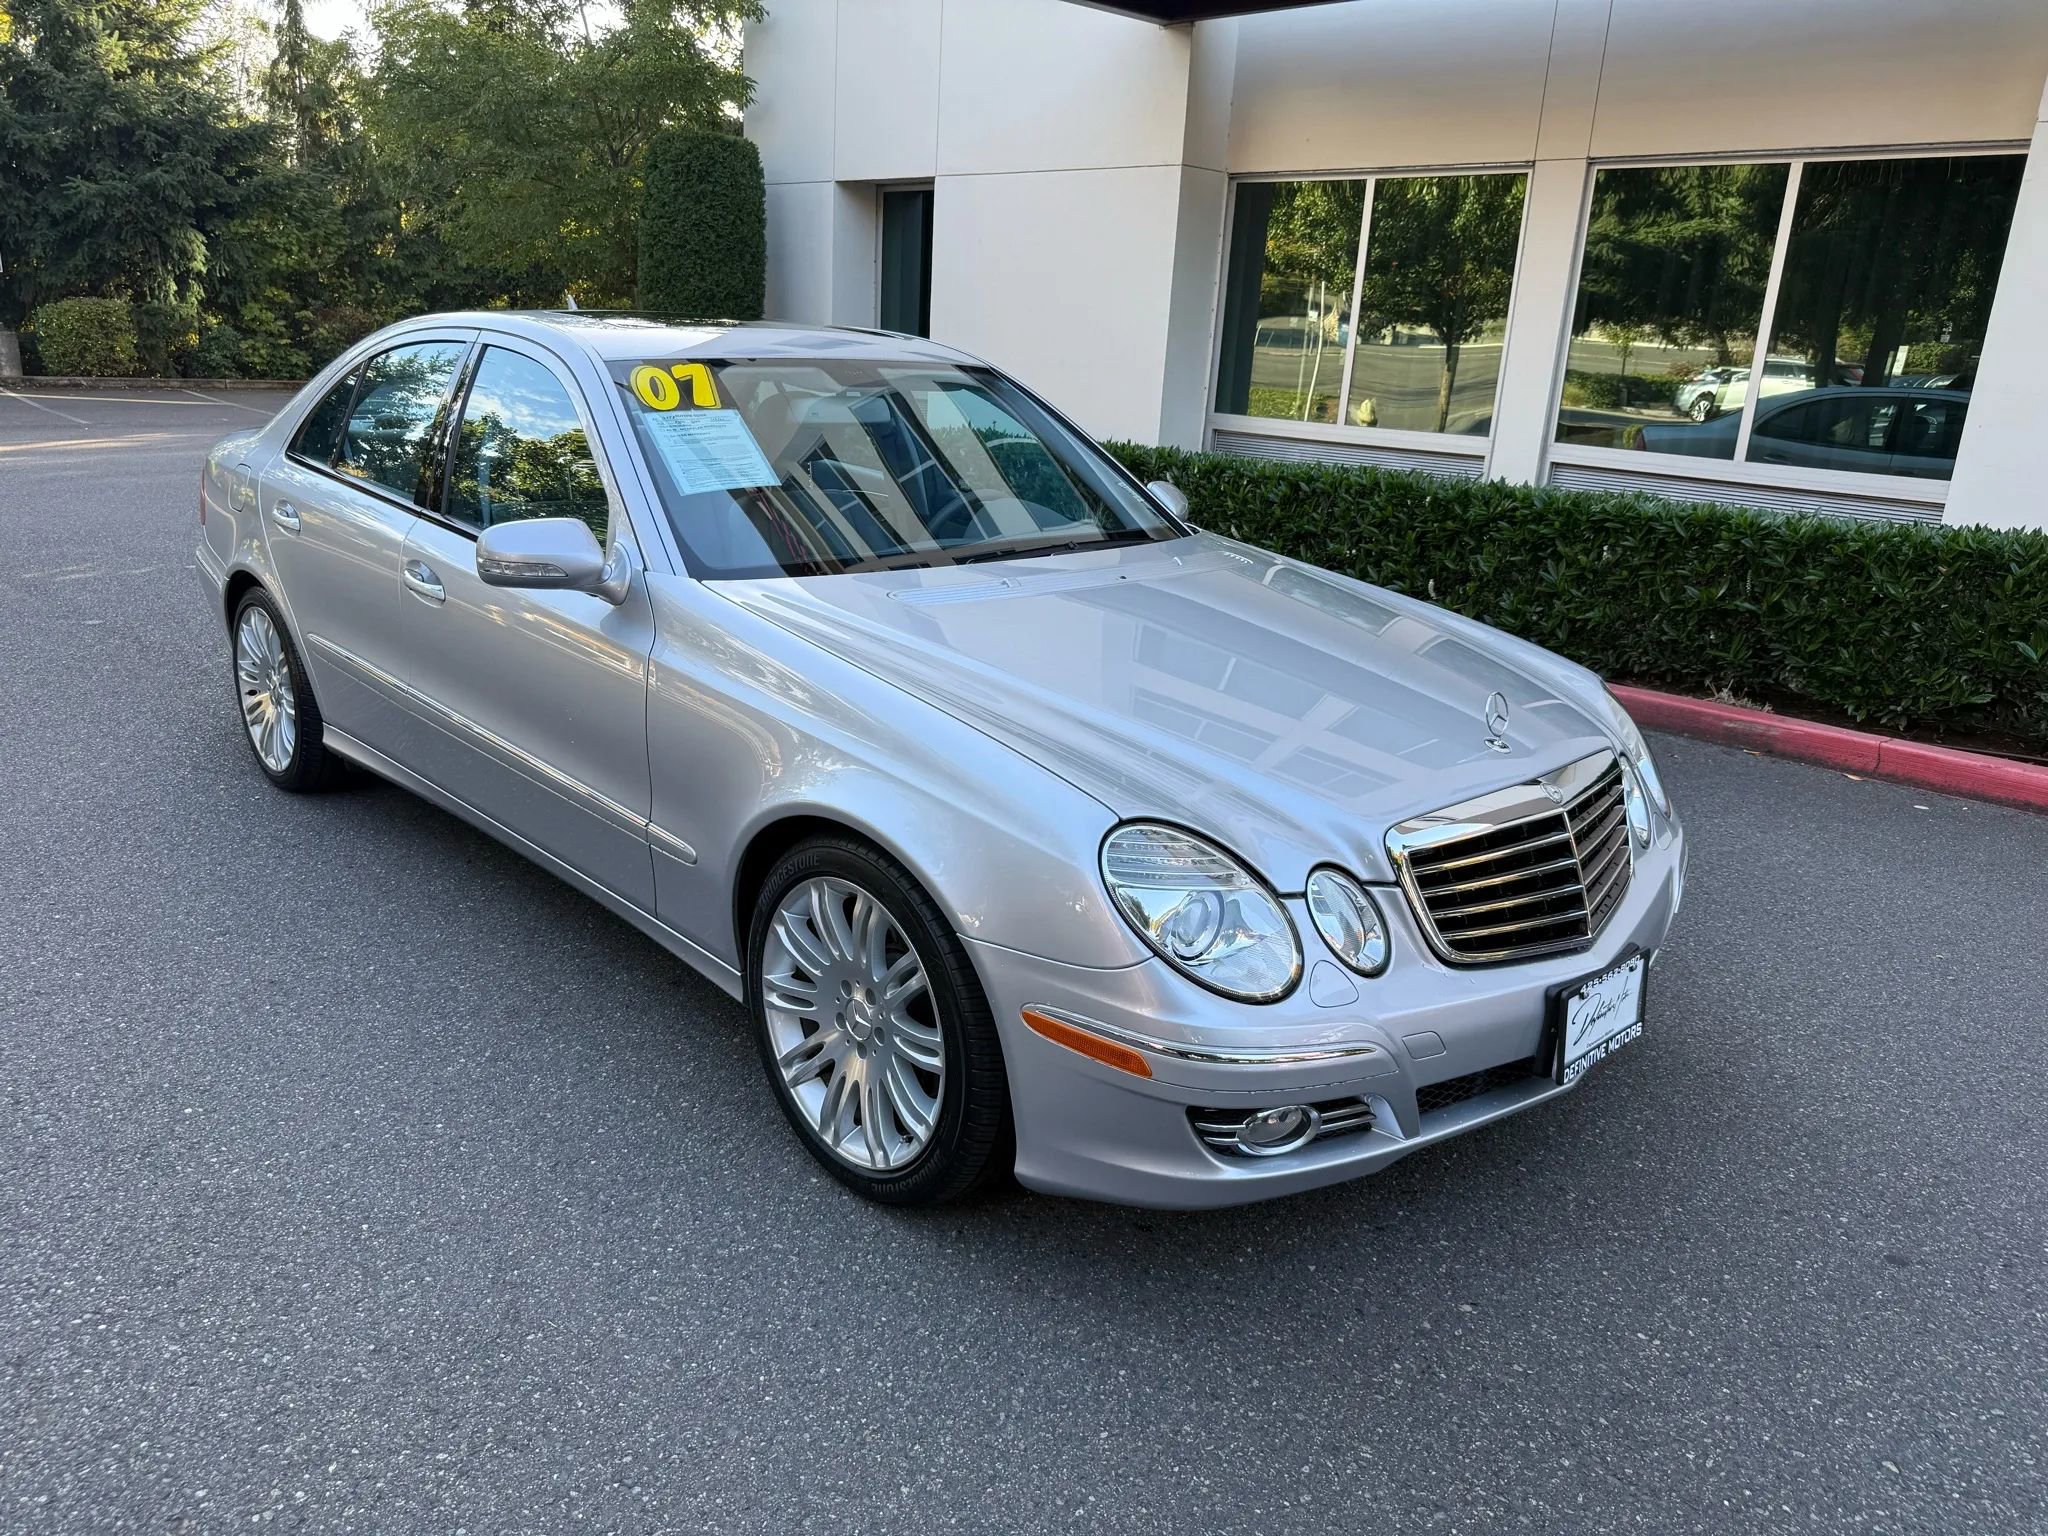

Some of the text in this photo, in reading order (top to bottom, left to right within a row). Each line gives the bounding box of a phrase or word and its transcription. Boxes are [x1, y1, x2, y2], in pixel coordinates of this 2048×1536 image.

[629, 363, 721, 411] 07
[1564, 1043, 1607, 1083] DEFINITIVE
[1607, 1022, 1643, 1054] MOTORS
